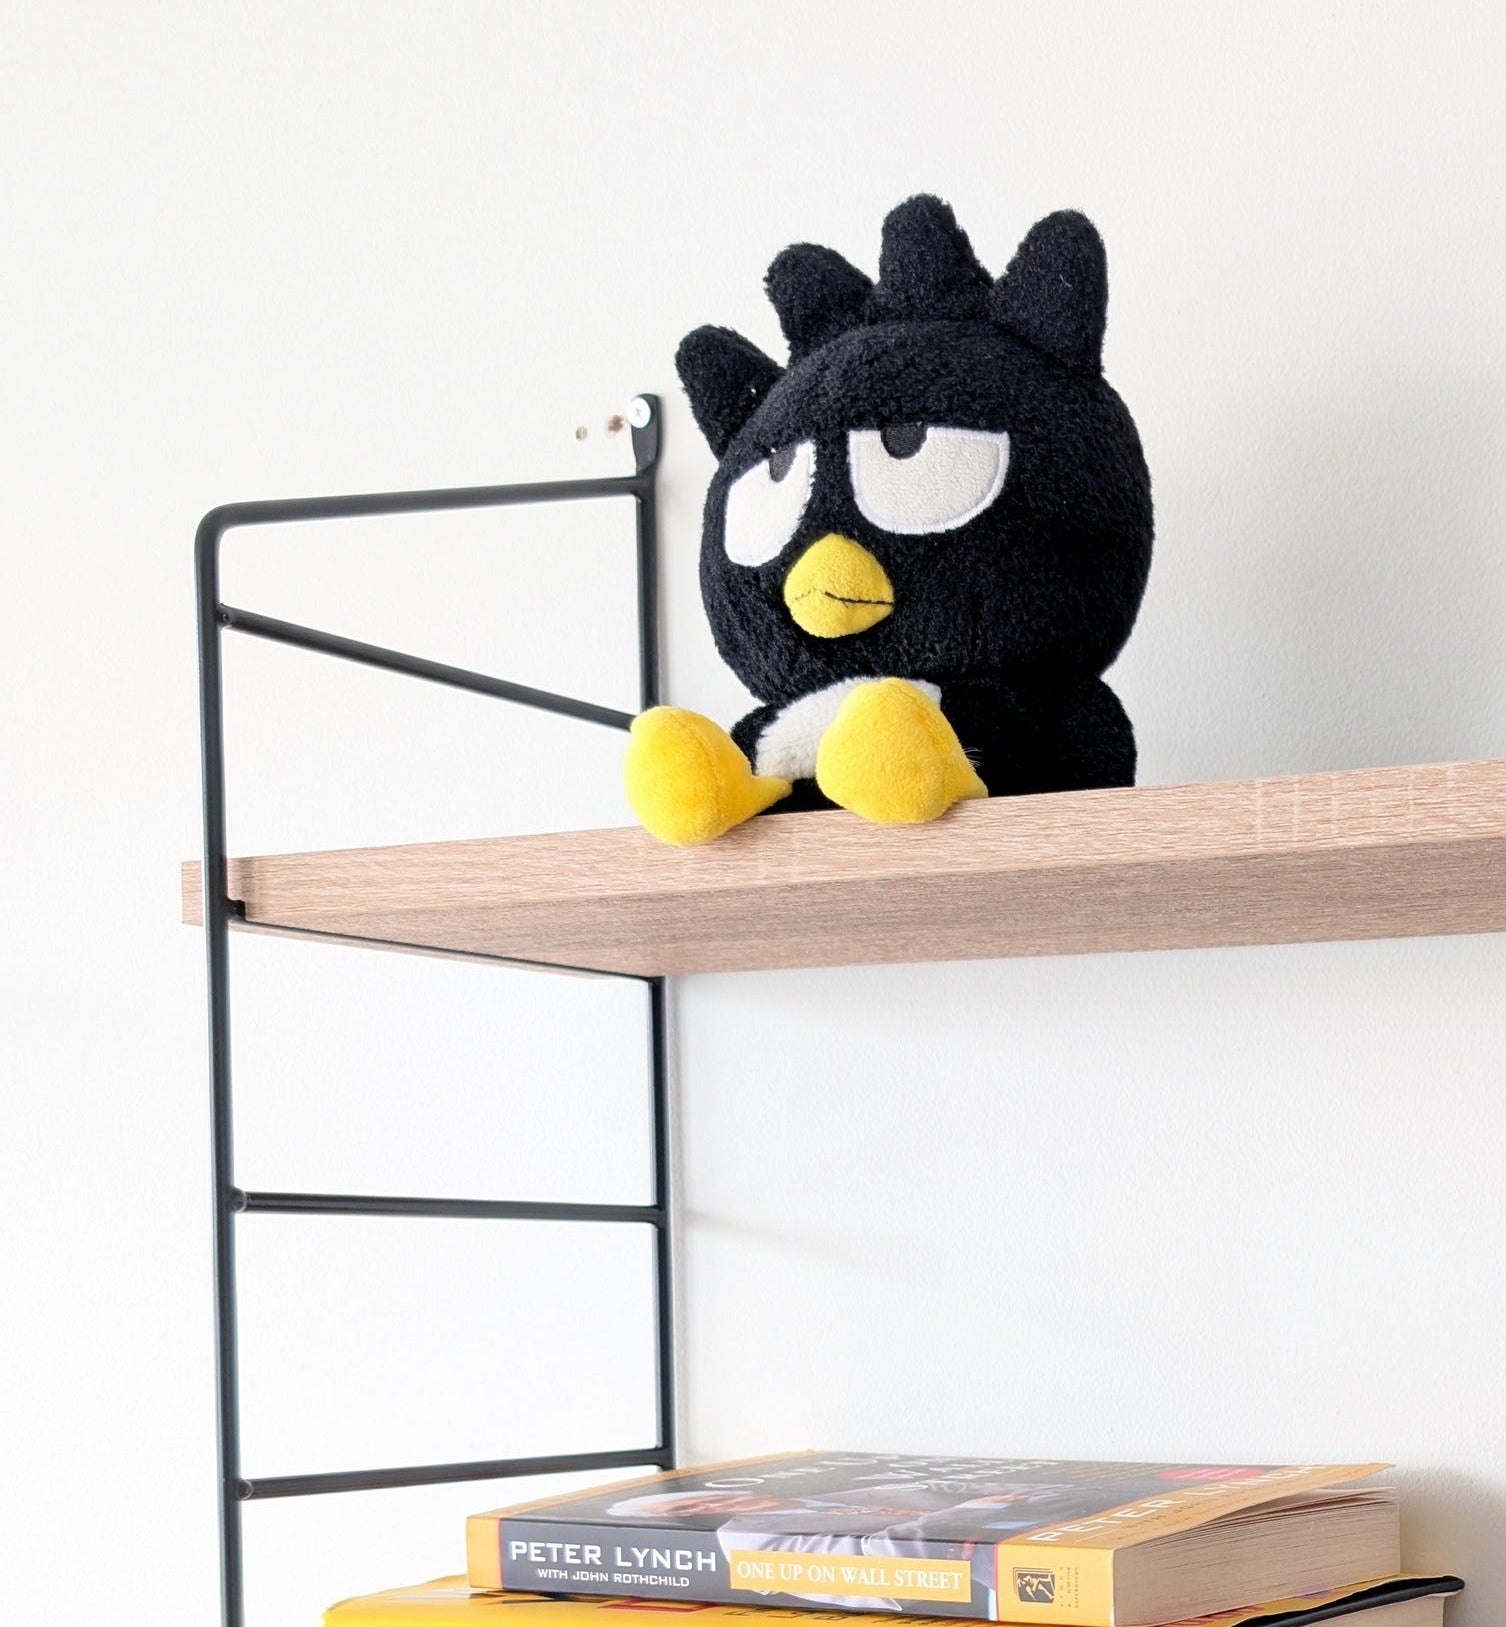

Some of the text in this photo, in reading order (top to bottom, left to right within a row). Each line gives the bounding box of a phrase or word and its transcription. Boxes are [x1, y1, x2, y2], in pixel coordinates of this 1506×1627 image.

[1026, 1499, 1186, 1542] PETER
[1184, 1464, 1327, 1497] LYNCH
[510, 1541, 717, 1572] PETER LYNCH
[538, 1568, 690, 1587] WITH JOHN ROTHCHILD
[737, 1560, 963, 1590] ONE UP ON WALL STREET
